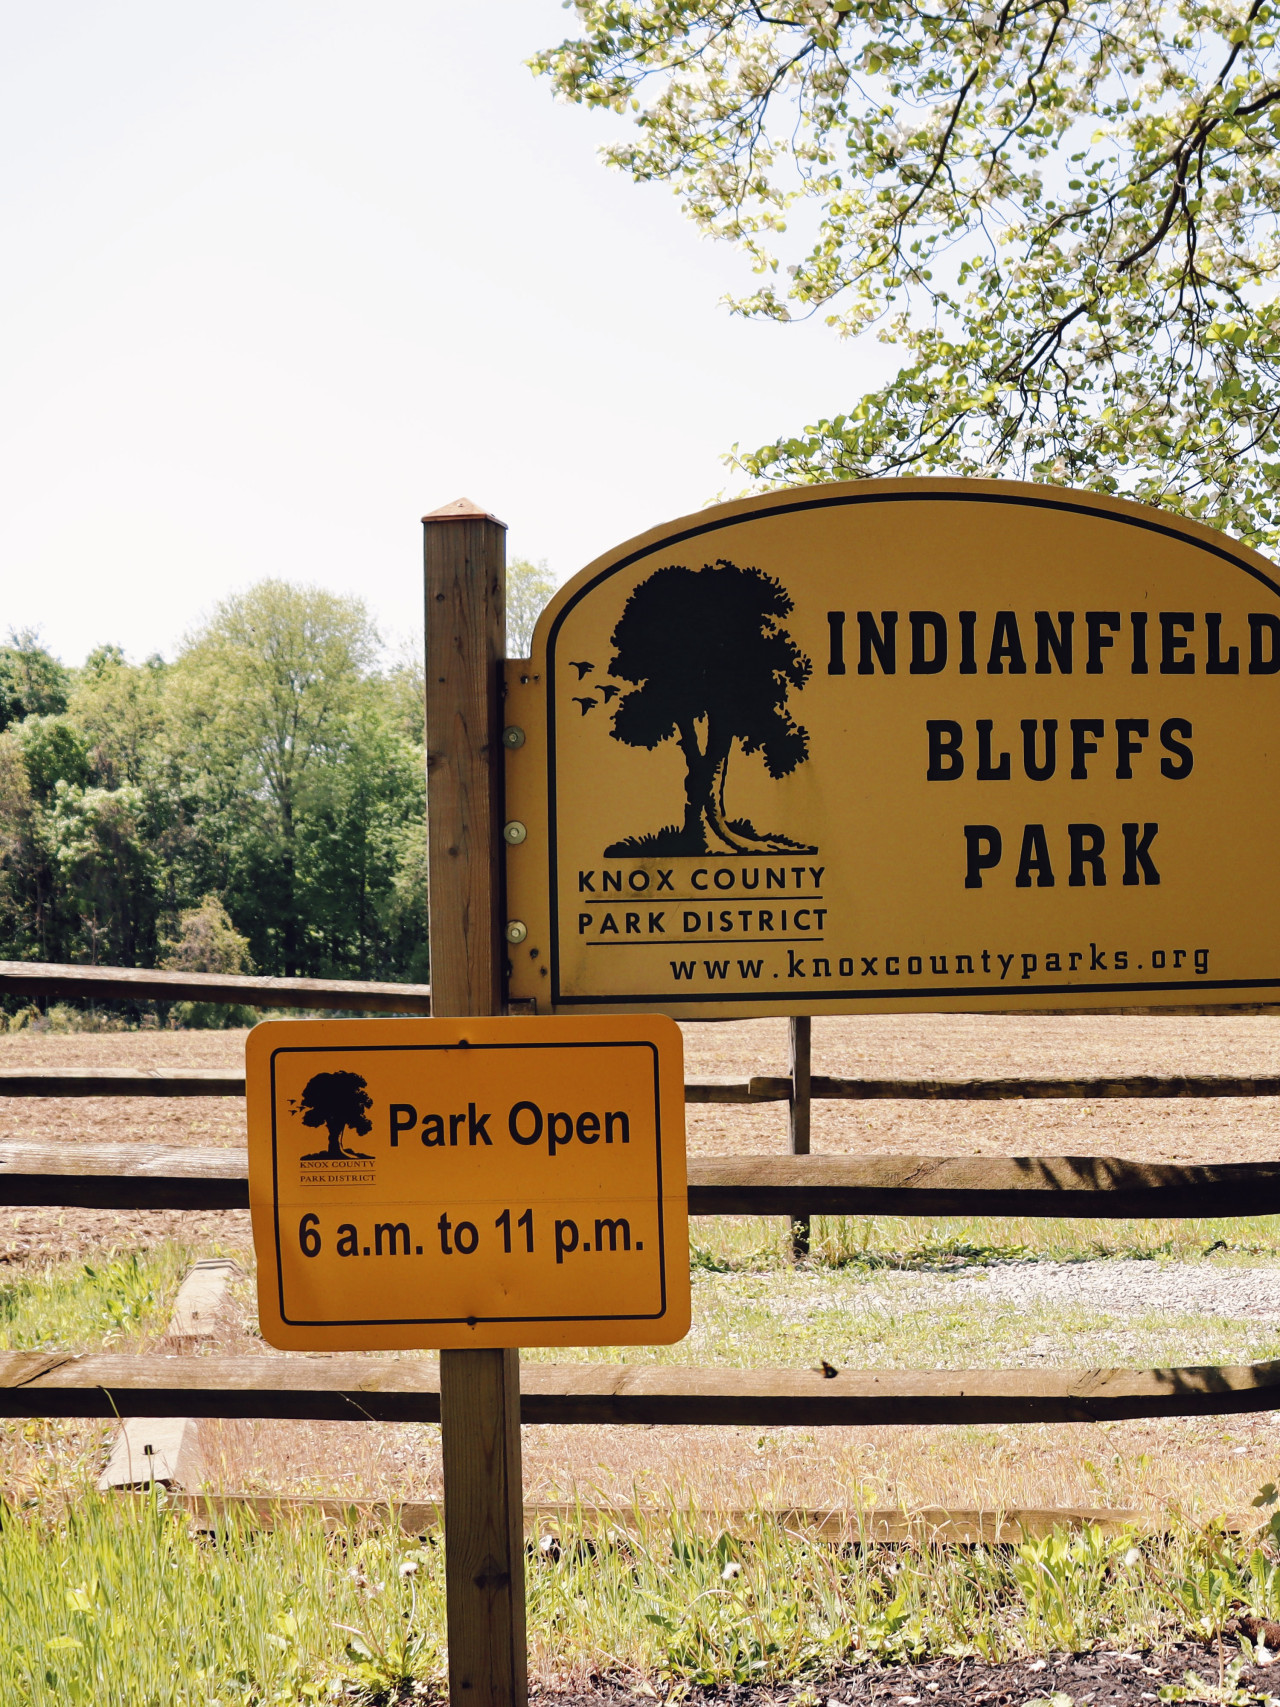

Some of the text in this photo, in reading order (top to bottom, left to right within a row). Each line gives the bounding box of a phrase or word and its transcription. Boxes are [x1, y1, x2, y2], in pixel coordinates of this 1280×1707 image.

[927, 717, 1195, 781] BLUFFS
[964, 822, 1162, 889] PARK
[578, 867, 825, 892] KNOX COUNTY
[578, 909, 827, 934] PARK DISTRICT
[670, 942, 1211, 981] www.knoxcountyparks.org
[389, 1101, 630, 1156] Park Open
[328, 1174, 376, 1182] DISTRICT
[331, 1160, 376, 1168] COUNTY
[299, 1208, 644, 1264] 6 a.m. to 11 p.m.
